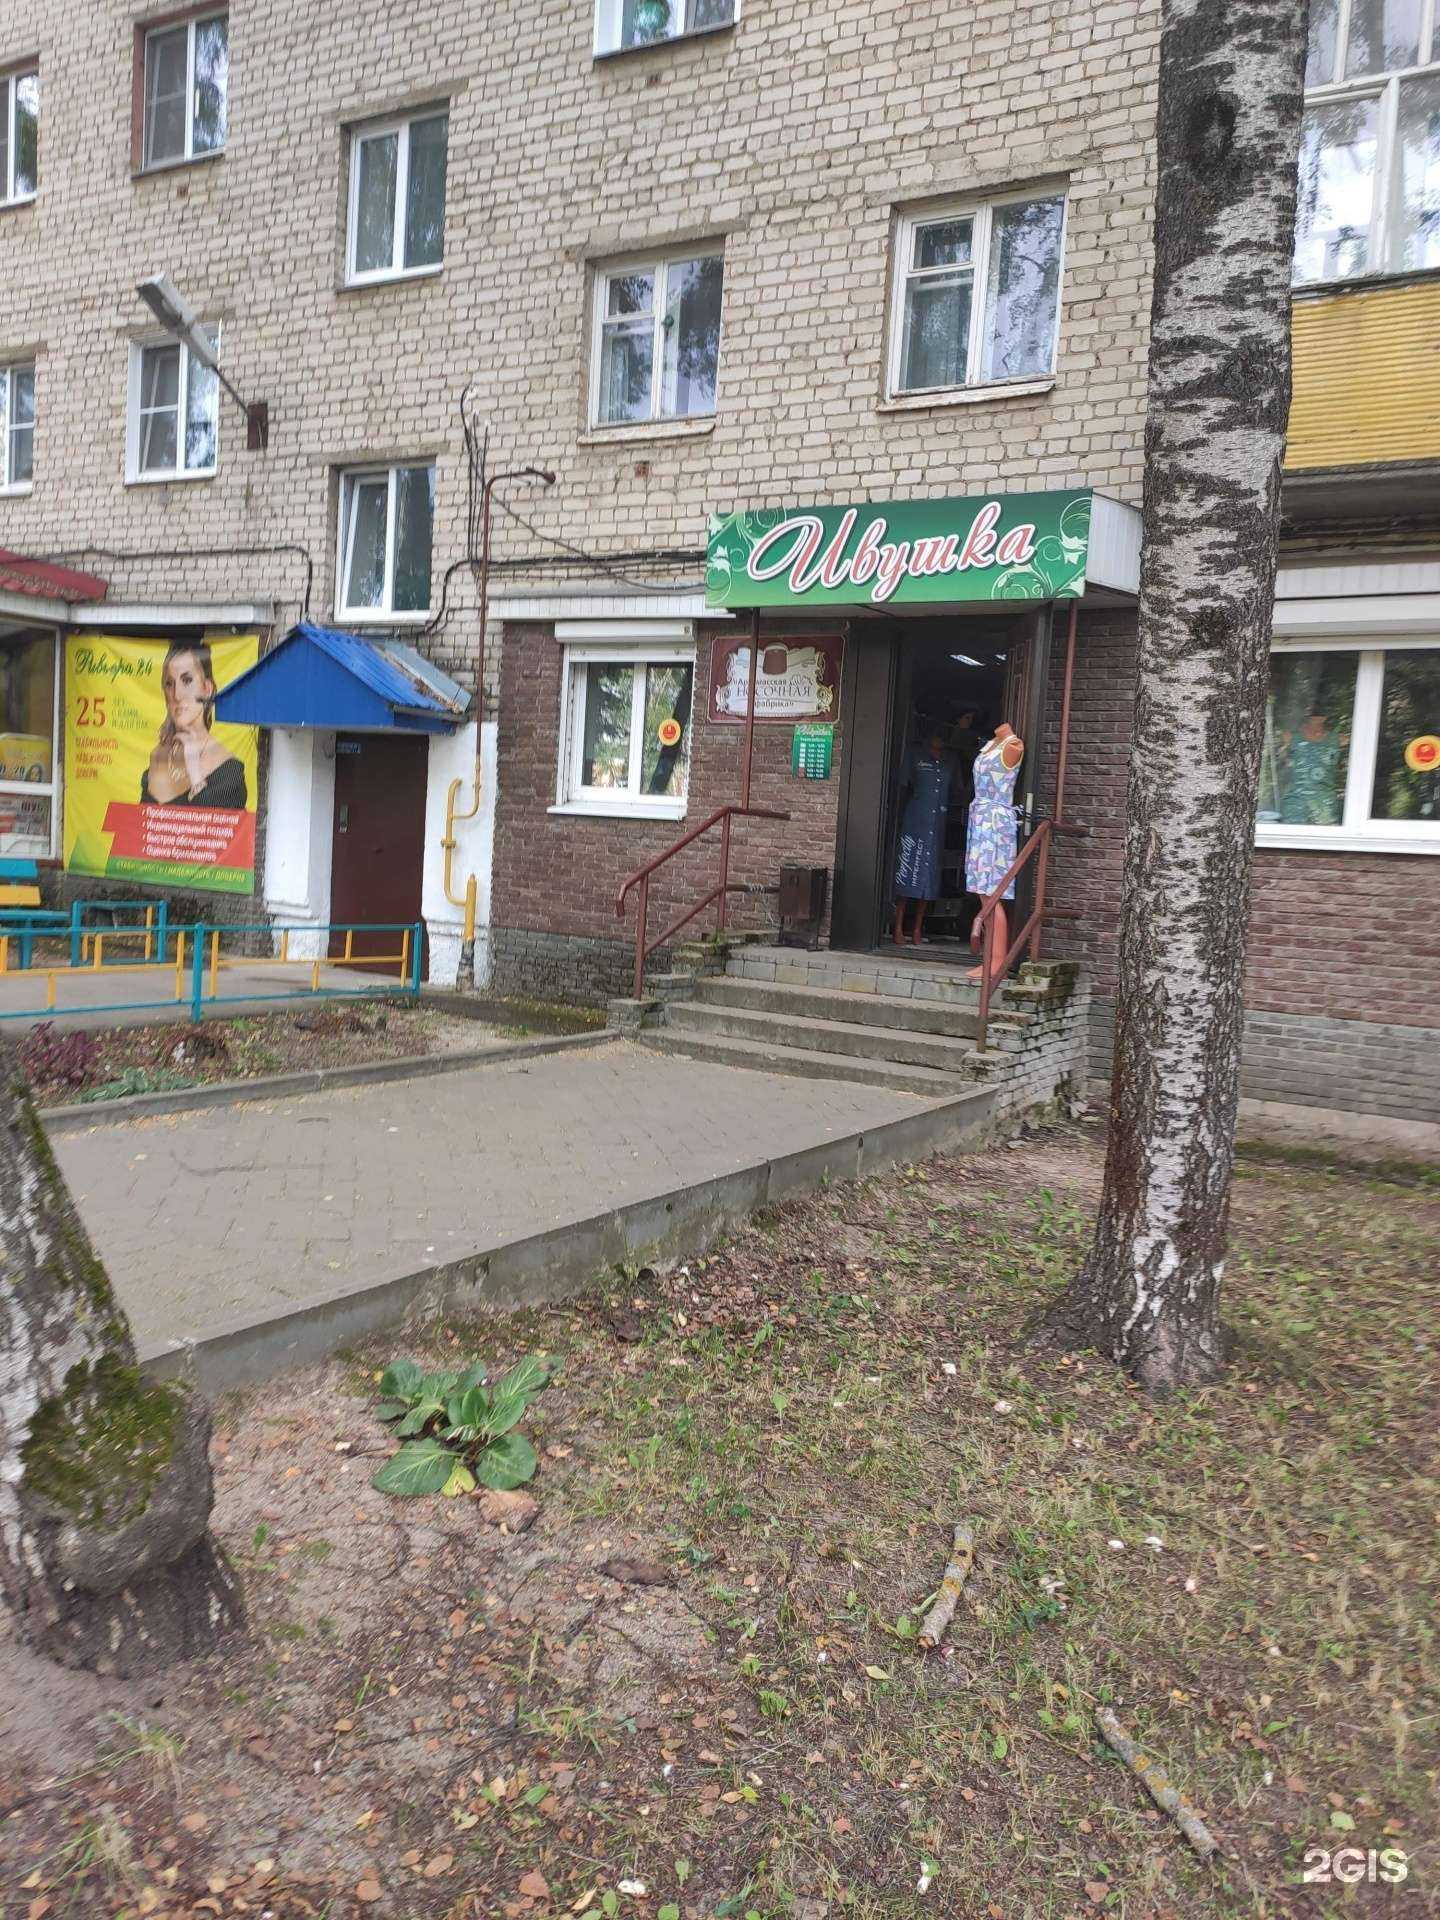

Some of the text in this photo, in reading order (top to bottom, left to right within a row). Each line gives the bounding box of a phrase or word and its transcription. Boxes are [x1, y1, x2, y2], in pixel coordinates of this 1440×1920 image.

[748, 501, 1037, 601] Ивушка
[736, 685, 811, 697] НСОЧНАЯ
[76, 696, 106, 727] 25
